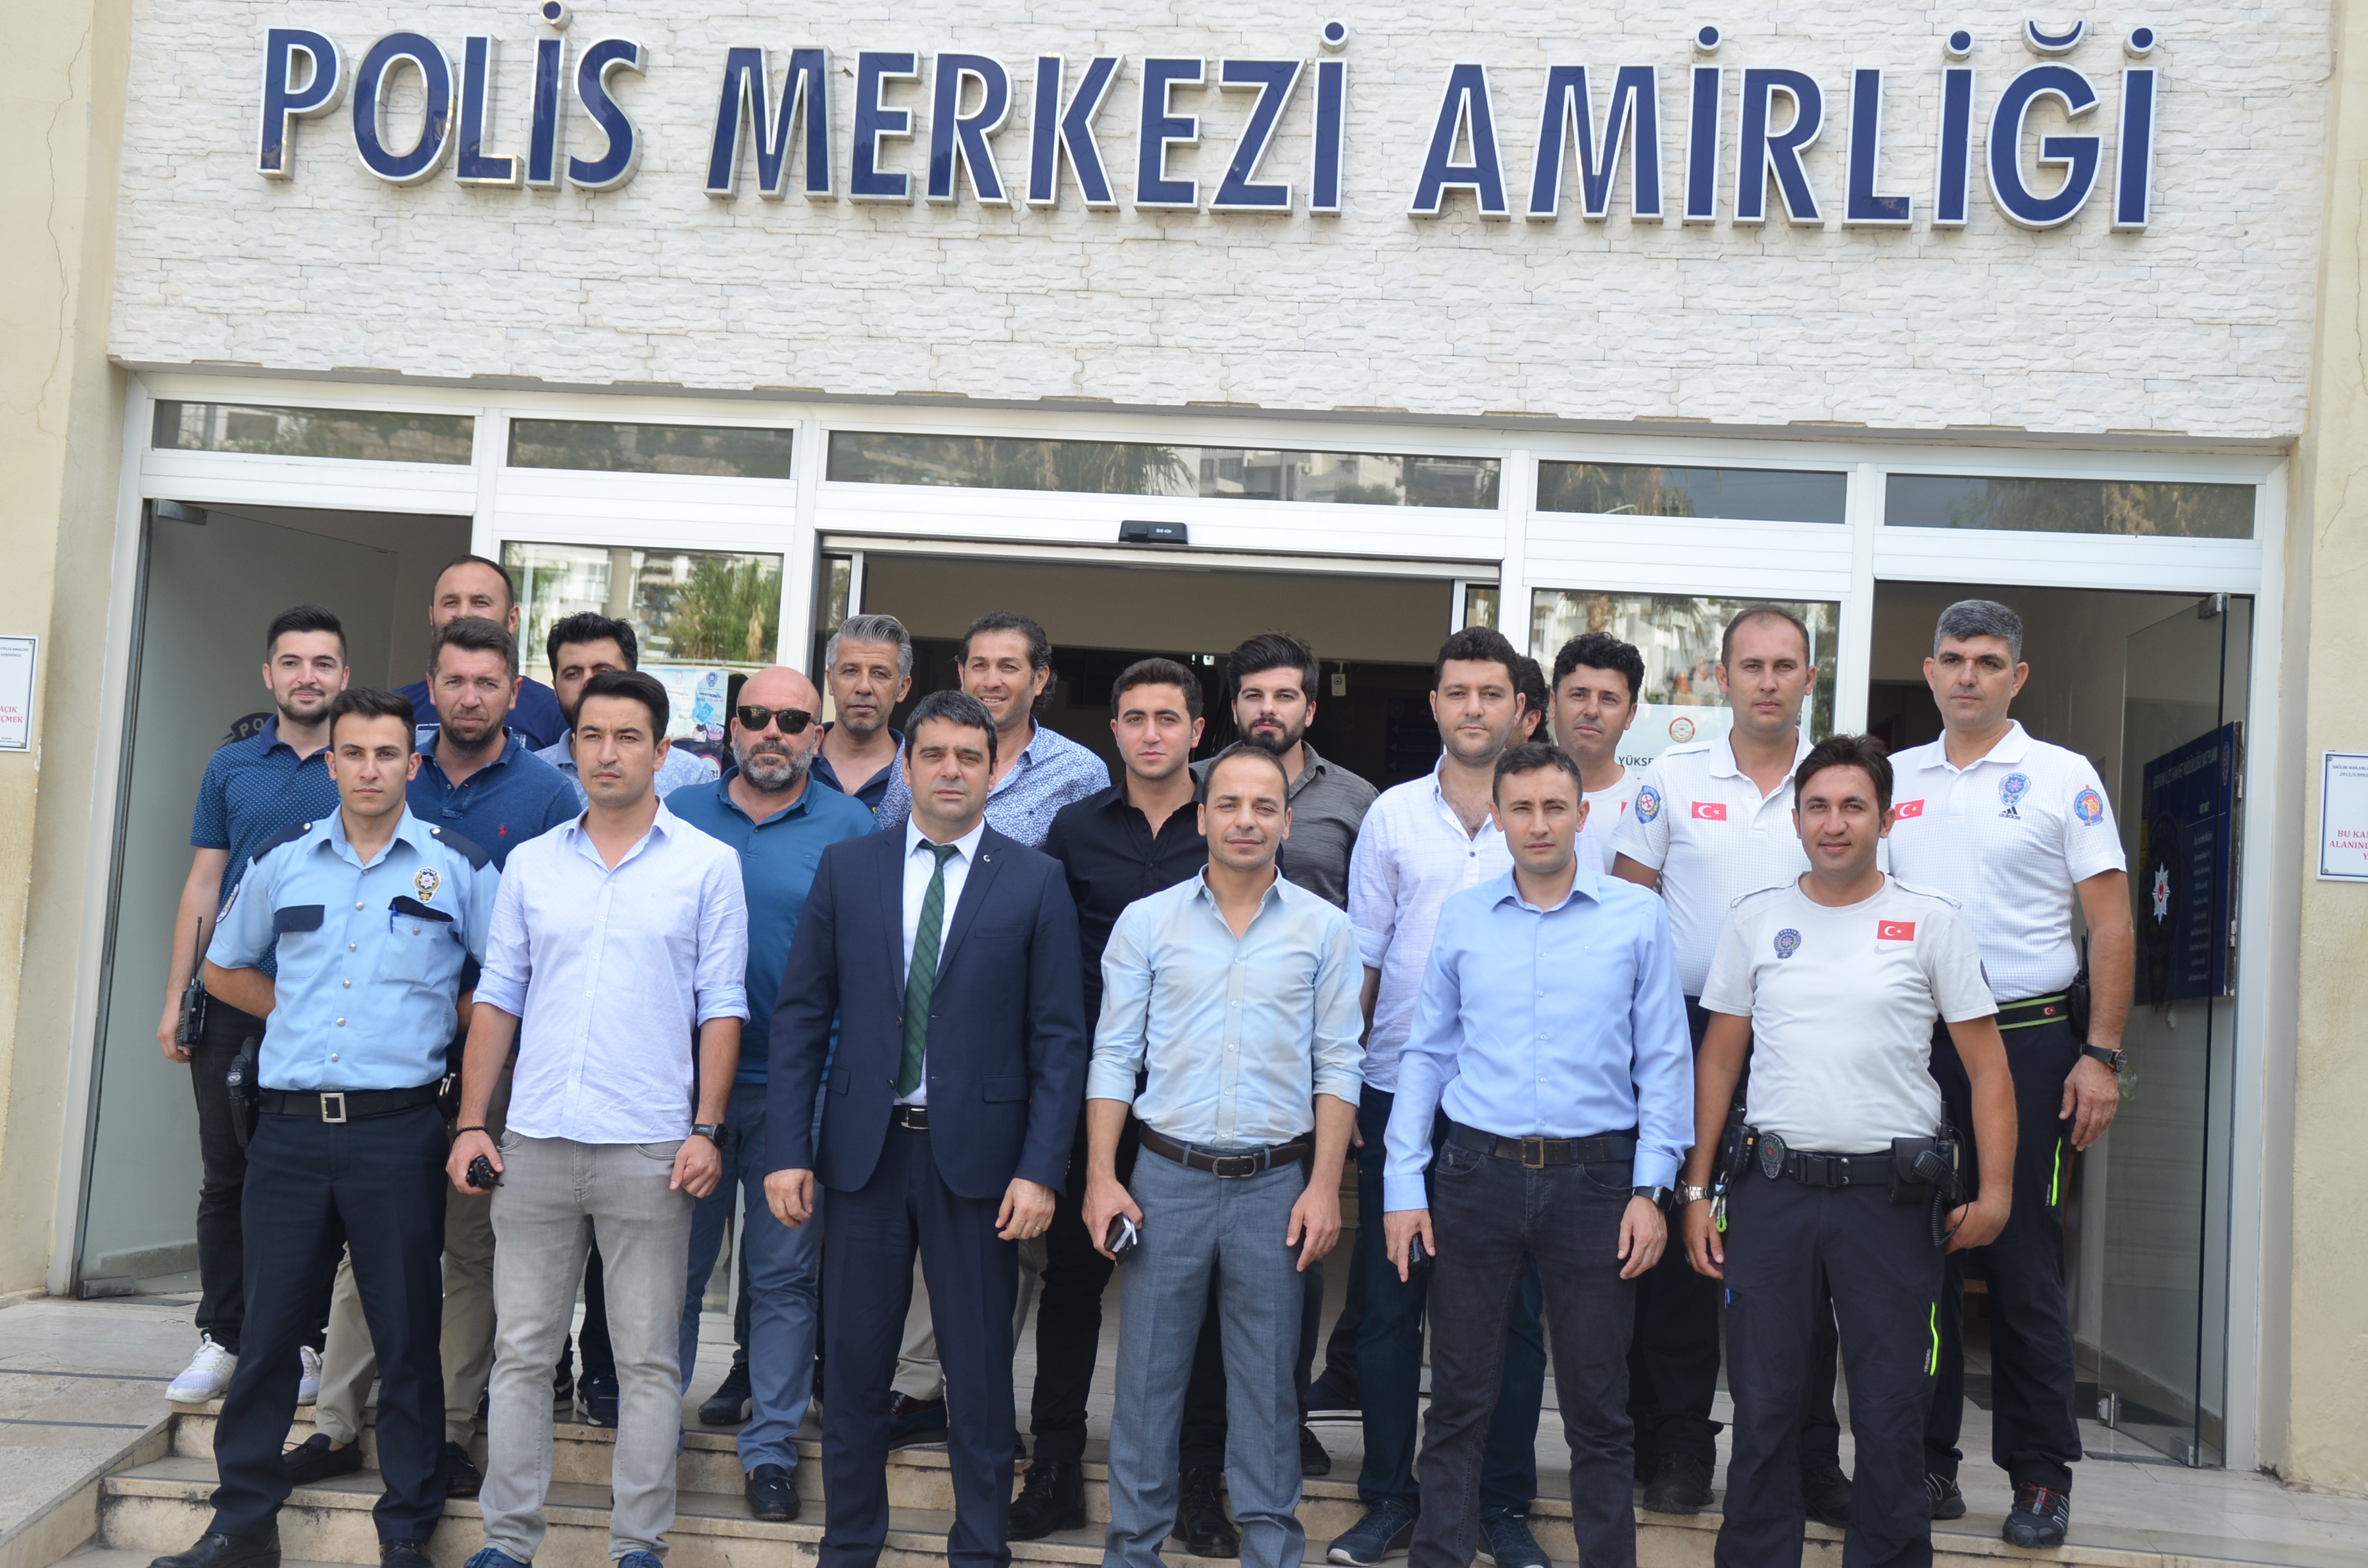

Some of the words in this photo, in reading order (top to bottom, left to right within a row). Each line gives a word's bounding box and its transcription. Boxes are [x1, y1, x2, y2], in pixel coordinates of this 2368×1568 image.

[256, 0, 647, 190] POLİS
[702, 17, 1349, 216] MERKEZİ
[1407, 9, 2159, 233] AMİRLİĞİ
